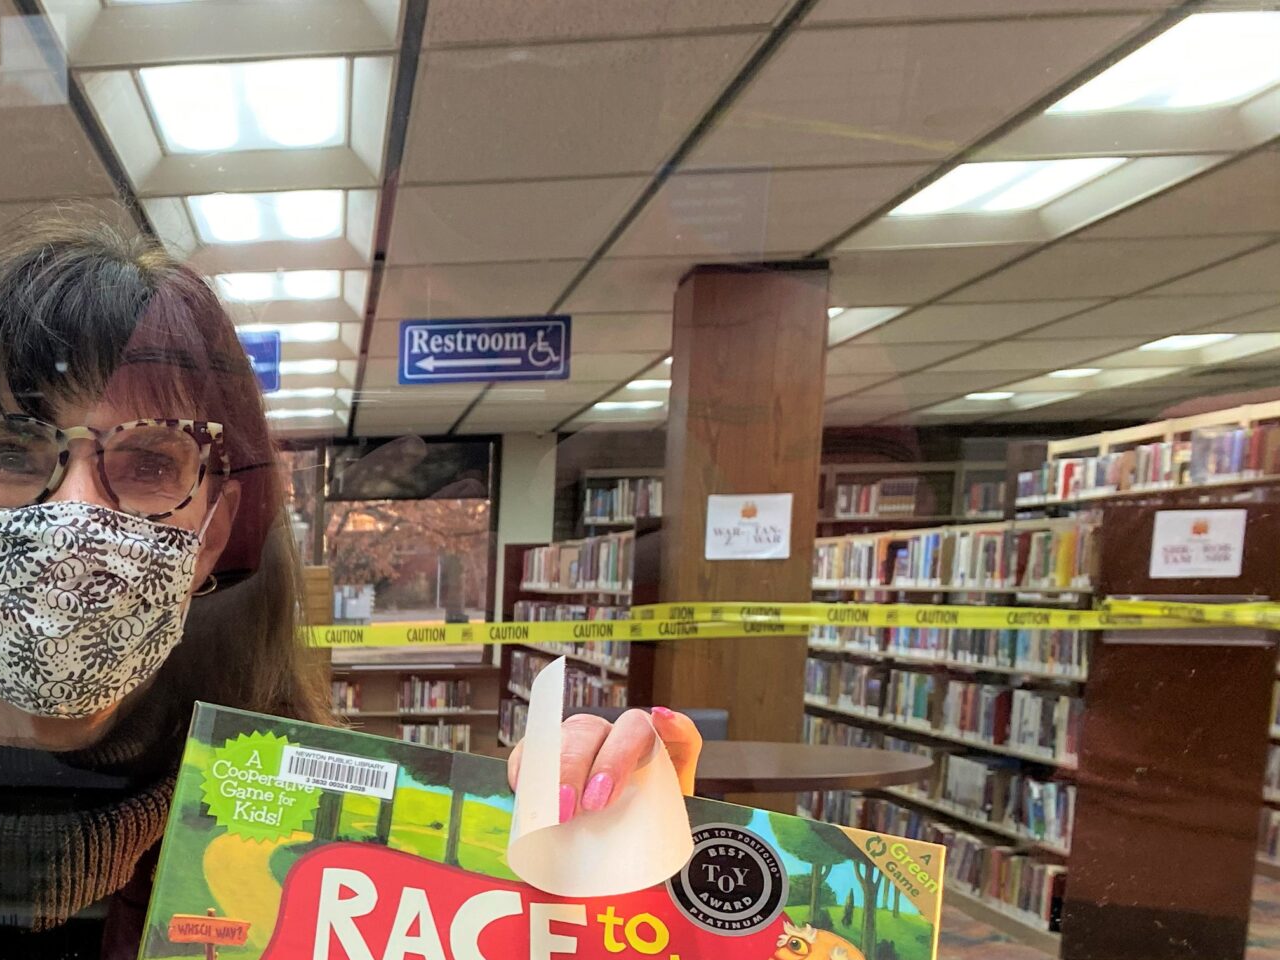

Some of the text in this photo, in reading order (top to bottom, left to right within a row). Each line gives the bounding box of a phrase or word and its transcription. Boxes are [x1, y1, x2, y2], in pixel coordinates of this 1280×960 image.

[411, 330, 526, 354] Restroom
[827, 608, 869, 622] CAUTION
[915, 609, 958, 624] CAUTION
[1006, 611, 1050, 625] CAUTION
[325, 629, 364, 644] CAUTION
[406, 628, 446, 642] CAUTION
[489, 626, 529, 640] CAUTION
[573, 623, 613, 638] CAUTION
[658, 622, 699, 636] CAUTION
[245, 751, 263, 769] A
[295, 751, 384, 770] NEWTON PUBLIC LIBRARY
[212, 760, 316, 794] Cooperative
[220, 780, 296, 806] Game for
[233, 802, 283, 826] Kids!
[714, 830, 733, 838] TOY
[708, 847, 745, 859] BEST
[919, 854, 931, 866] A
[891, 843, 938, 893] Green
[702, 864, 750, 893] TOY
[885, 861, 920, 897] Game
[699, 892, 752, 911] AWARD
[690, 907, 763, 929] PLATINUM
[178, 923, 243, 939] WHICH WAY?
[596, 906, 670, 955] to
